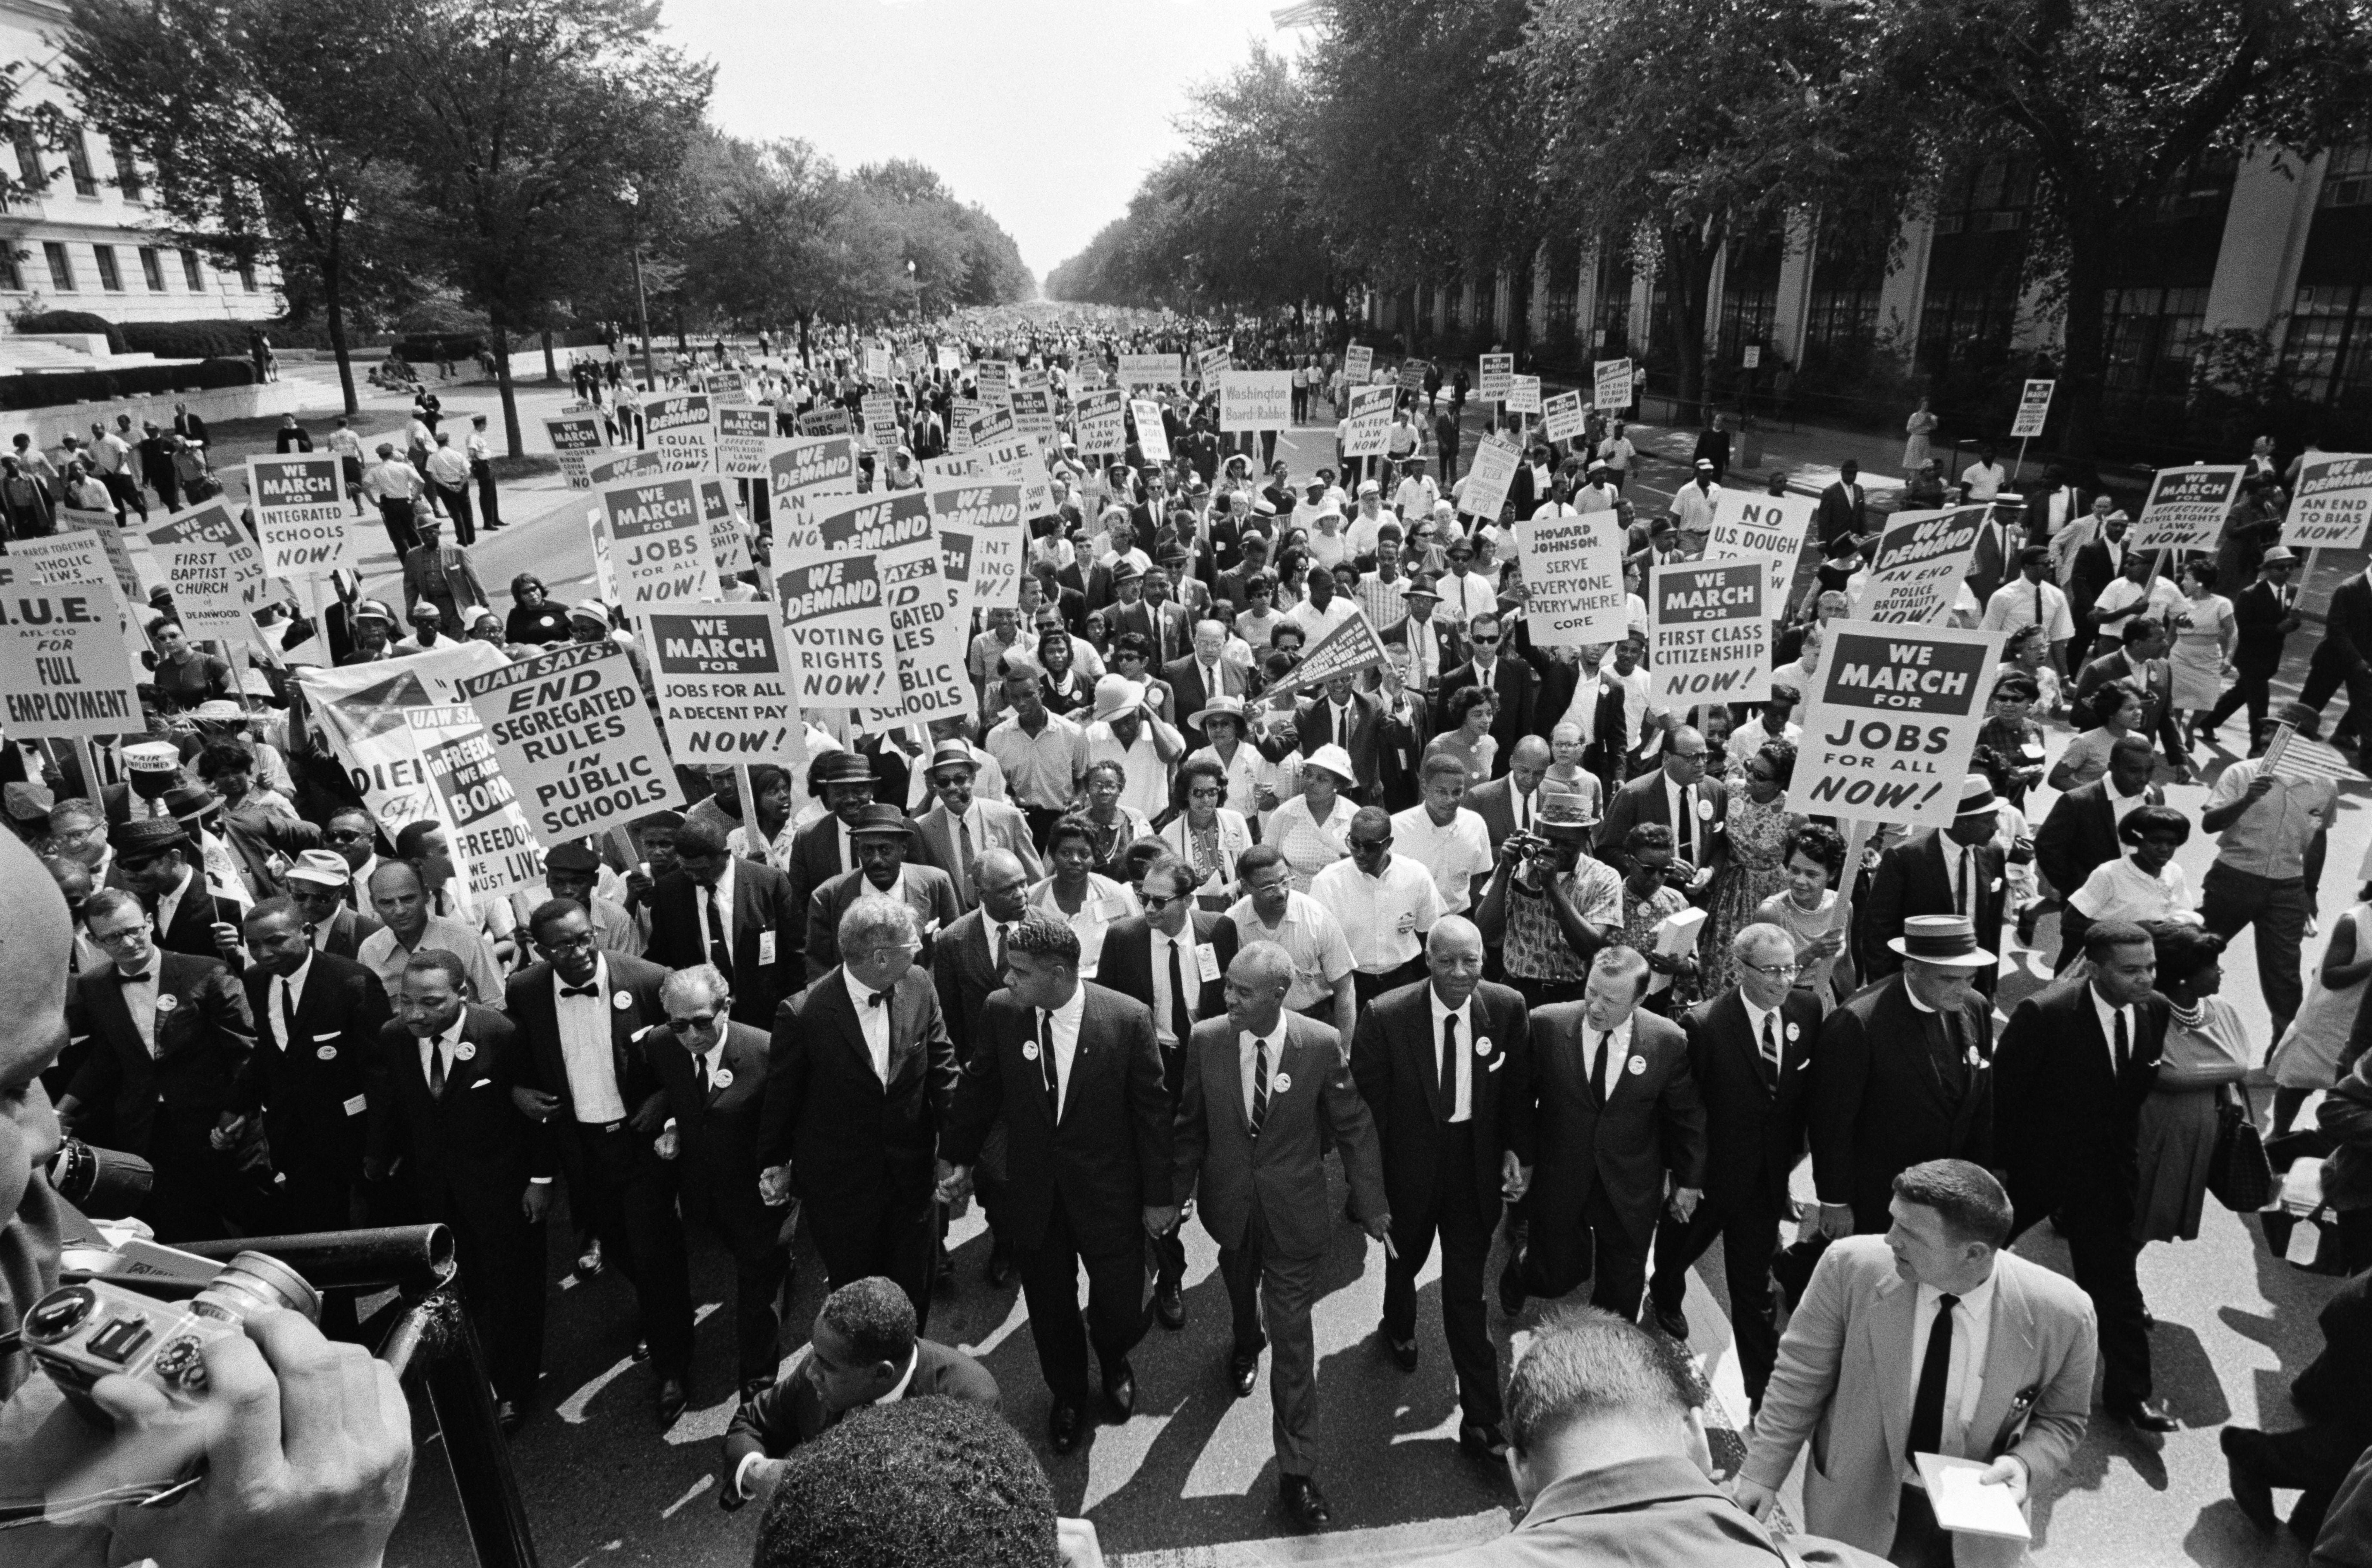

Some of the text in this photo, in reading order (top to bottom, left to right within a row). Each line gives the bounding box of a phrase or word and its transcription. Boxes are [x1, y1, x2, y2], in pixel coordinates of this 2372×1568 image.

[710, 380, 739, 389] MARCH
[1485, 388, 1510, 397] NOW!
[1226, 386, 1286, 402] Washington
[1601, 394, 1628, 405] NOW!
[665, 397, 688, 413] WE
[1015, 400, 1045, 409] MARCH
[1079, 400, 1120, 420] DEMAND
[1226, 406, 1286, 420] Board Rabbis
[1352, 397, 1392, 418] DEMAND
[650, 407, 709, 431] DEMAND
[724, 419, 767, 430] MARCH
[737, 412, 753, 420] WE
[982, 414, 997, 428] WE
[1369, 418, 1390, 426] FEPC
[562, 422, 579, 431] WE
[807, 424, 834, 436] JOBS
[974, 418, 1011, 442] DEMAND
[1081, 419, 1120, 431] AN FEPC
[1553, 424, 1580, 437] NOW!
[554, 430, 596, 443] MARCH
[658, 435, 705, 445] EQUAL
[1359, 430, 1381, 438] LAW
[1085, 437, 1120, 450] NOW!
[1352, 438, 1386, 450] NOW!
[796, 444, 826, 467] WE
[282, 464, 307, 477] WE
[613, 457, 638, 475] WE
[725, 461, 767, 473] NOW!
[776, 455, 850, 491] DEMAND
[2326, 459, 2359, 476] WE
[263, 477, 331, 495] MARCH
[2185, 474, 2209, 483] WE
[2302, 470, 2372, 494] DEMAND
[285, 494, 313, 502] FOR
[637, 487, 665, 503] WE
[956, 488, 992, 509] WE
[2159, 483, 2226, 497] MARCH
[779, 495, 805, 510] AN
[2154, 505, 2221, 514] EFFECTIVE
[2302, 499, 2367, 511] AN END
[262, 507, 342, 524] INTEGRATED
[617, 498, 692, 526] MARCH
[855, 502, 893, 532] WE
[1742, 504, 1784, 526] NO
[2143, 514, 2221, 524] CIVIL RIGHTS
[2300, 512, 2363, 524] TO BIAS
[174, 518, 201, 534] WE
[266, 526, 344, 543] SCHOOLS
[643, 520, 673, 532] FOR
[1534, 524, 1591, 541] HOWARD
[1913, 516, 1955, 542] WE
[2294, 525, 2360, 540] NOW!
[50, 539, 97, 554] TOGETHER
[1714, 526, 1799, 554] U.S. DOUGH
[2141, 531, 2210, 545] NOW!
[277, 542, 342, 567] NOW!
[626, 535, 698, 566] JOBS
[1879, 527, 1975, 569] DEMAND
[175, 553, 216, 565] FIRST
[1546, 558, 1589, 574] SERVE
[171, 567, 227, 581] BAPTIST
[632, 559, 699, 579] FOR ALL
[808, 562, 844, 591] WE
[1880, 565, 1953, 582] AN END
[636, 570, 706, 602] NOW!
[1531, 575, 1612, 595] EVERYONE
[1694, 571, 1726, 588] WE
[176, 582, 228, 595] CHURCH
[1890, 583, 1934, 598] POLICE
[787, 579, 878, 620] DEMAND
[1528, 593, 1620, 614] EVERYWHERE
[1666, 585, 1754, 610] MARCH
[1873, 594, 1939, 610] BRUTALITY
[185, 610, 240, 619] DEANWOOD
[1693, 608, 1728, 619] FOR
[1871, 601, 1946, 624] NOW!
[690, 619, 729, 636] WE
[1554, 616, 1593, 630] CORE
[792, 627, 884, 646] VOTING
[1335, 628, 1367, 653] AND LET THE
[1659, 624, 1762, 646] FIRST CLASS
[37, 639, 73, 651] FOR
[665, 638, 767, 658] MARCH
[1301, 621, 1363, 670] WE WANT FREEDOM
[801, 651, 883, 669] RIGHTS
[1298, 638, 1372, 681] FOR JOBS FREEDOM
[1347, 648, 1379, 667] MARCH
[1654, 643, 1765, 665] CITIZENSHIP
[1889, 643, 1934, 665] WE
[36, 656, 81, 686] FULL
[473, 662, 530, 694] UAW
[537, 644, 613, 675] SAYS:
[699, 661, 739, 671] FOR
[804, 670, 886, 696] NOW!
[1666, 666, 1757, 695] NOW!
[1837, 663, 1968, 696] MARCH
[508, 669, 602, 715] END
[665, 682, 786, 698] JOBS FOR ALL
[6, 690, 129, 722] EMPLOYMENT
[869, 685, 962, 721] SCHOOLS
[1873, 693, 1923, 709] FOR
[413, 709, 452, 728] UAW
[491, 685, 636, 745] SEGREGATED
[668, 705, 789, 720] A DECENT PAY
[521, 715, 626, 763] RULES
[689, 727, 787, 753] NOW!
[1824, 719, 1951, 755] JOBS
[567, 752, 601, 773] IN
[1823, 752, 1936, 774] FOR ALL
[456, 757, 500, 786] WE ARE
[536, 755, 653, 808] PUBLIC
[1809, 776, 1943, 811] NOW!
[542, 778, 667, 834] SCHOOLS
[468, 861, 487, 877] WE
[468, 872, 504, 894] MUST
